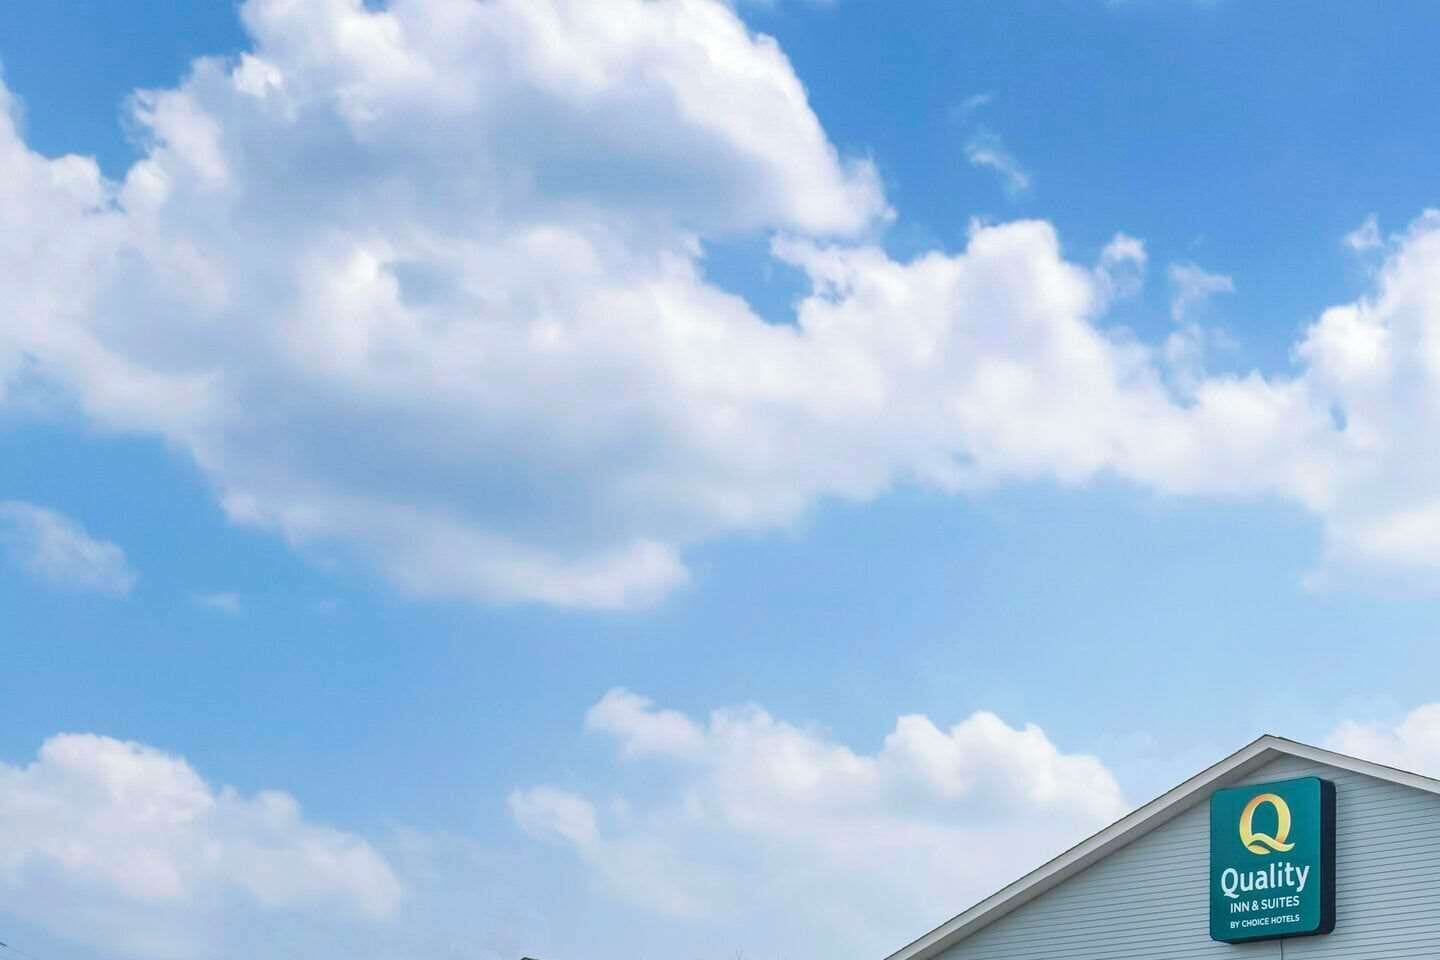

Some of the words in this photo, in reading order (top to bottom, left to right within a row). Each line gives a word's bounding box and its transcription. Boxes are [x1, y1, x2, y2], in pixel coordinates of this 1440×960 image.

[1239, 793, 1295, 855] Q
[1221, 862, 1310, 899] Quality
[1230, 901, 1250, 913] INN
[1251, 900, 1259, 911] &
[1261, 895, 1300, 910] SUITES
[1230, 920, 1240, 929] BY
[1241, 917, 1270, 928] CHOICE
[1271, 914, 1300, 924] HOTELS
